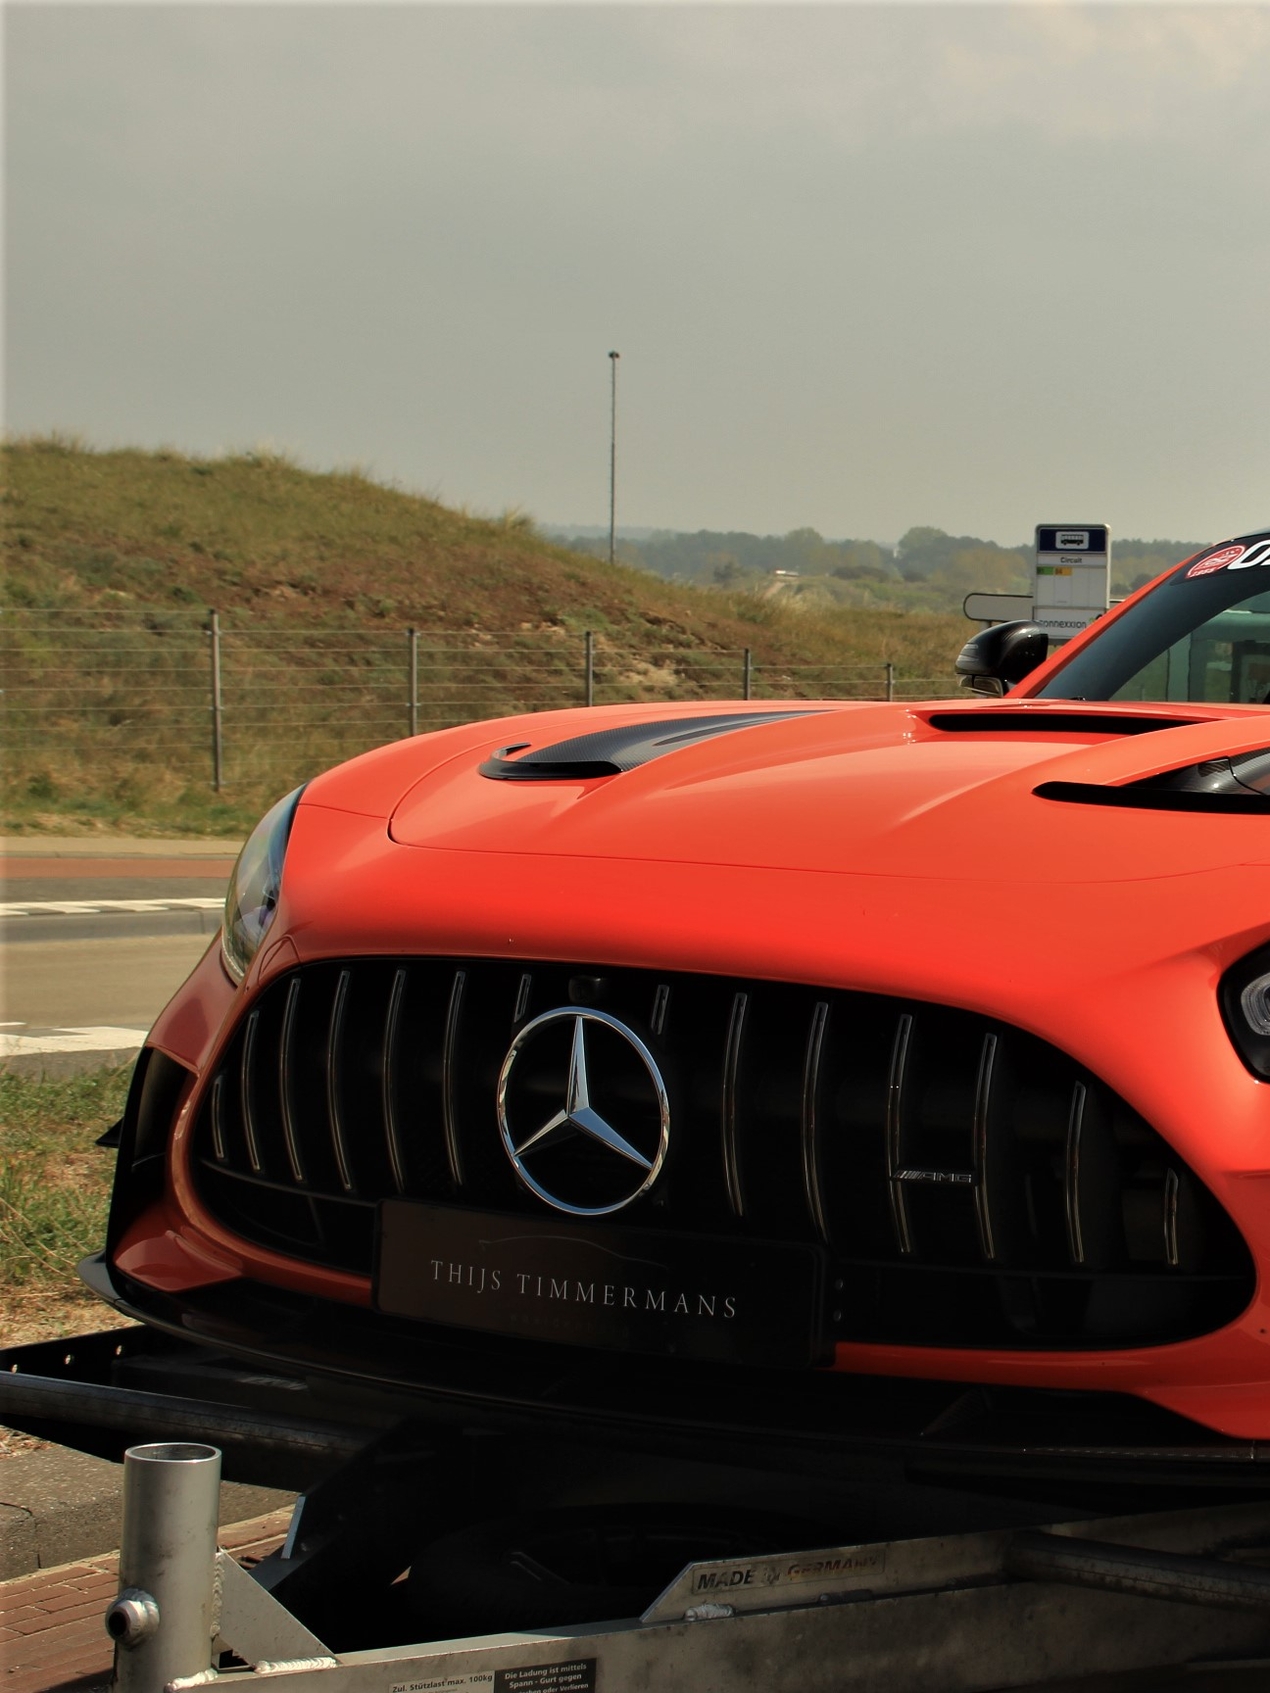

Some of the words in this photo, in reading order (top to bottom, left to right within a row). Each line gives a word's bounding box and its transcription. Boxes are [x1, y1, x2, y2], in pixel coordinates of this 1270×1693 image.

[1060, 556, 1082, 564] Circuit
[431, 1260, 502, 1293] THIJS
[516, 1273, 737, 1319] TIMMERMANS
[698, 1569, 756, 1590] MADE
[504, 1672, 518, 1680] Die
[519, 1668, 548, 1679] Ladung
[549, 1666, 559, 1674] ist
[560, 1663, 587, 1672] mittels
[392, 1685, 408, 1693] Zul.
[410, 1680, 446, 1692] Stützlast
[447, 1678, 466, 1686] max.
[469, 1674, 493, 1684] 100kg
[509, 1679, 534, 1689] Spann
[540, 1675, 558, 1684] Gurt
[558, 1673, 582, 1683] gegen
[560, 1683, 589, 1692] Verlieren
